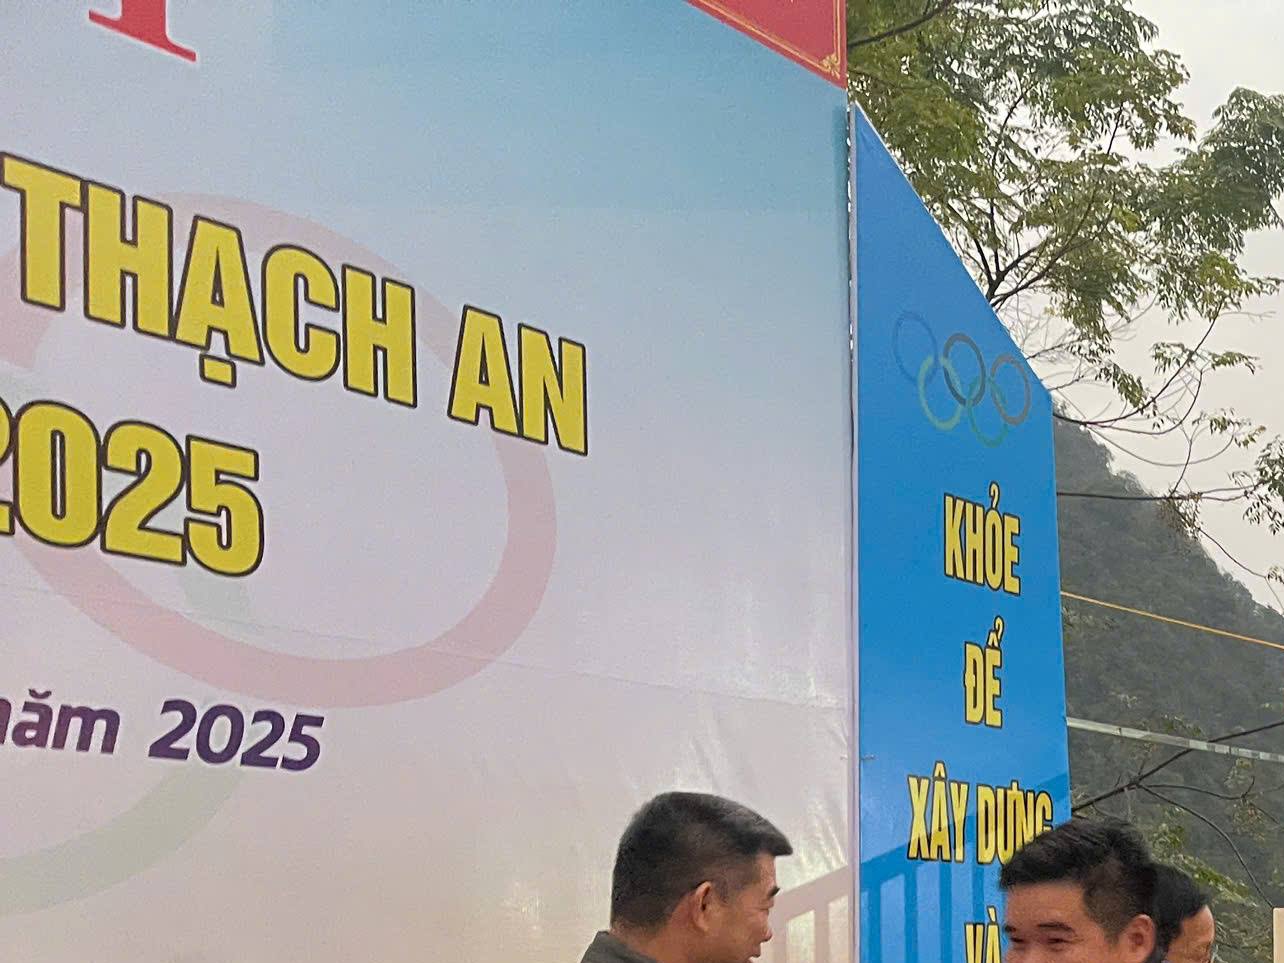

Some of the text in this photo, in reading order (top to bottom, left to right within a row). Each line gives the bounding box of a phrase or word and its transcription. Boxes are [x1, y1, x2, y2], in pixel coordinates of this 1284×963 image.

[0, 151, 588, 456] THẠCH AN
[0, 396, 265, 577] 025
[943, 480, 1020, 596] KHỎE
[963, 615, 1004, 728] ĐỂ
[148, 699, 325, 771] 2025
[907, 760, 970, 863] XÂY
